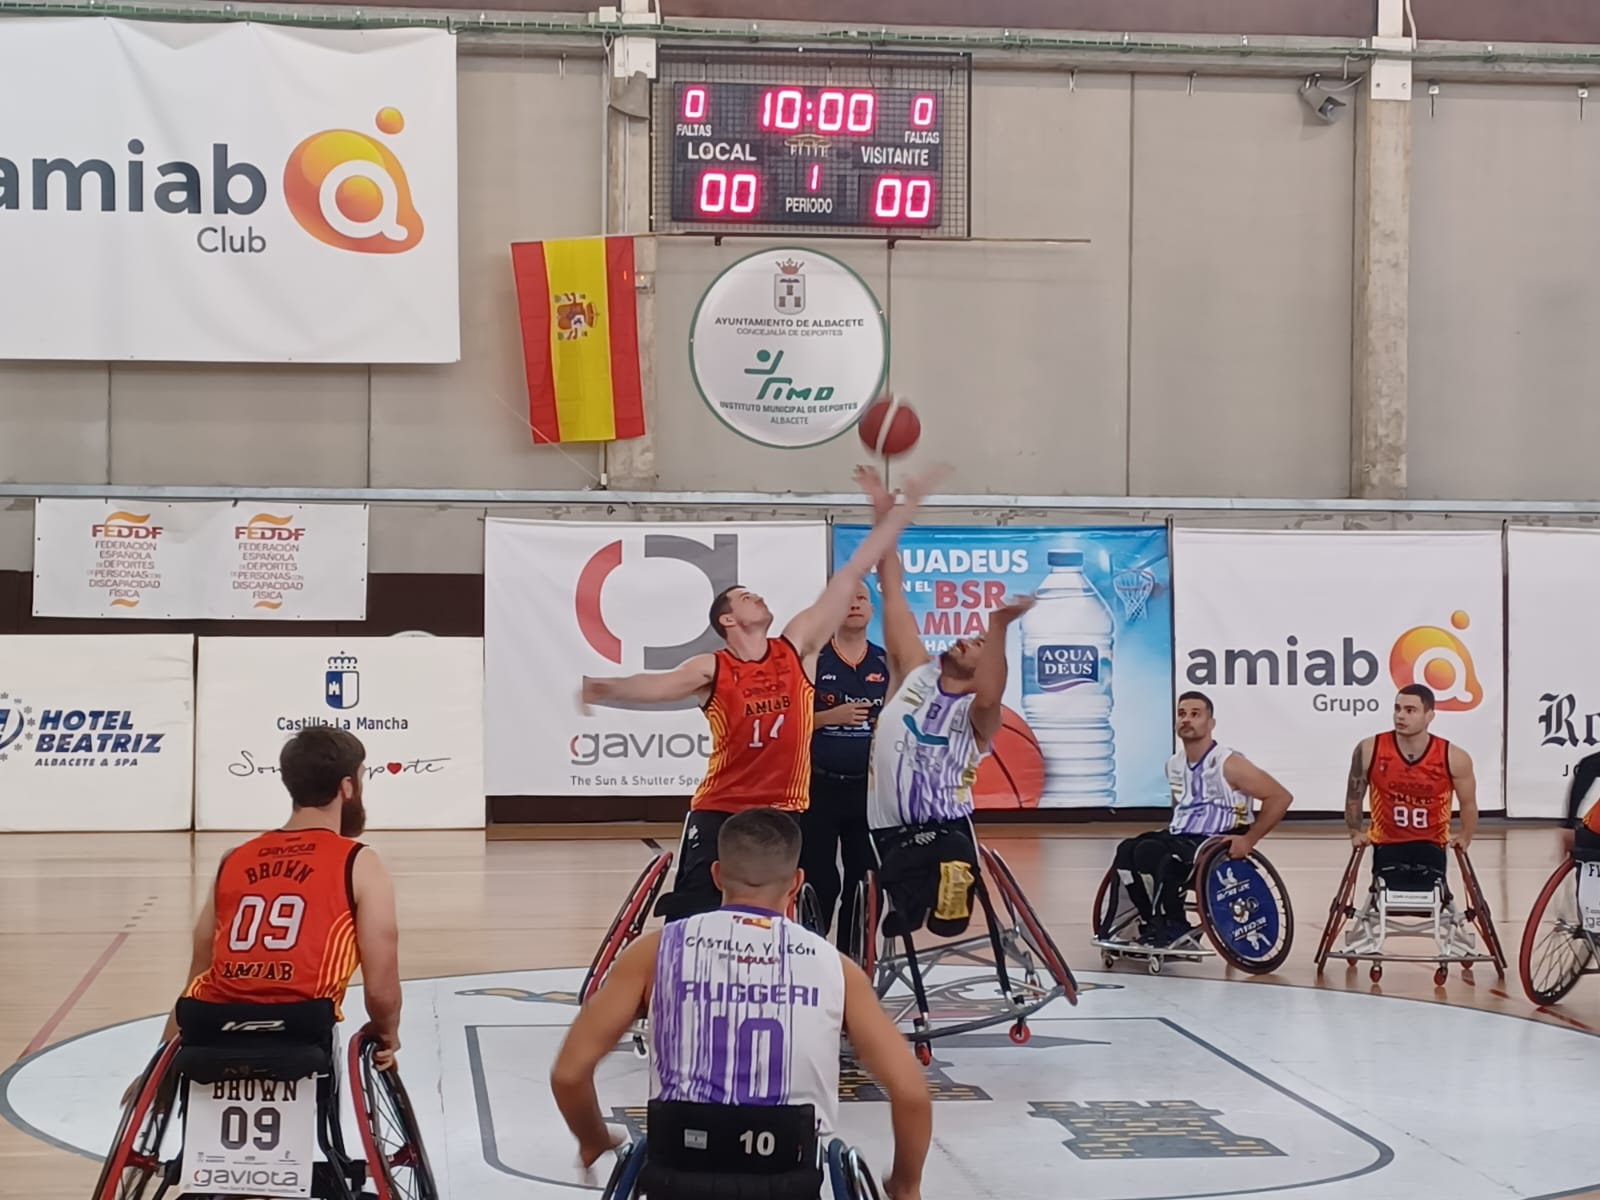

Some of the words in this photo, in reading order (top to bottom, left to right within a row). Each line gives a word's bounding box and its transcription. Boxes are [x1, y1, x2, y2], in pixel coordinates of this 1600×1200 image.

[684, 89, 705, 118] 0
[763, 90, 874, 131] 10:00
[913, 97, 933, 126] 0
[676, 124, 712, 137] FALTAS
[904, 131, 940, 144] FALTAS
[687, 142, 757, 161] LOCAL
[861, 146, 929, 166] VISITANTE
[700, 174, 757, 213] 00
[875, 178, 931, 218] 00
[785, 197, 833, 214] PERIODO
[196, 226, 267, 254] Club
[714, 316, 794, 327] AYUNTAMIENTO
[796, 319, 809, 327] DE
[812, 318, 865, 327] ALBACETE
[719, 401, 761, 412] INSTITUTO
[763, 402, 805, 414] MUNICIPAL
[807, 404, 817, 414] DE
[819, 402, 858, 413] DEPORTES
[770, 417, 809, 425] ALBACETE
[871, 549, 1029, 574] UADEUS
[915, 581, 932, 592] EL
[935, 580, 1006, 609] BSR
[911, 611, 986, 635] MIA
[1042, 649, 1095, 664] AQUA
[1186, 635, 1379, 686] amiab
[1044, 663, 1093, 675] DEUS
[1312, 694, 1379, 717] Grupo
[38, 710, 134, 731] HOTEL
[356, 716, 409, 731] Mancha
[35, 733, 165, 753] BEATRIZ
[569, 733, 713, 766] gaviot
[35, 758, 96, 767] ALBACETE
[114, 758, 138, 767] SPA
[570, 775, 592, 786] The
[595, 775, 617, 786] Sun
[621, 775, 628, 786] &
[632, 775, 675, 786] Shutter
[245, 859, 315, 885] BROWN
[228, 895, 305, 951] 09
[685, 936, 754, 953] CASTILLA
[763, 942, 772, 955] Y
[778, 943, 816, 956] LEÓN
[681, 980, 819, 1007] RUGGERI
[711, 1015, 784, 1105] 10
[213, 1077, 297, 1102] BROWN
[221, 1106, 281, 1151] 09
[739, 1130, 776, 1156] 10
[194, 1169, 298, 1187] gaviota
